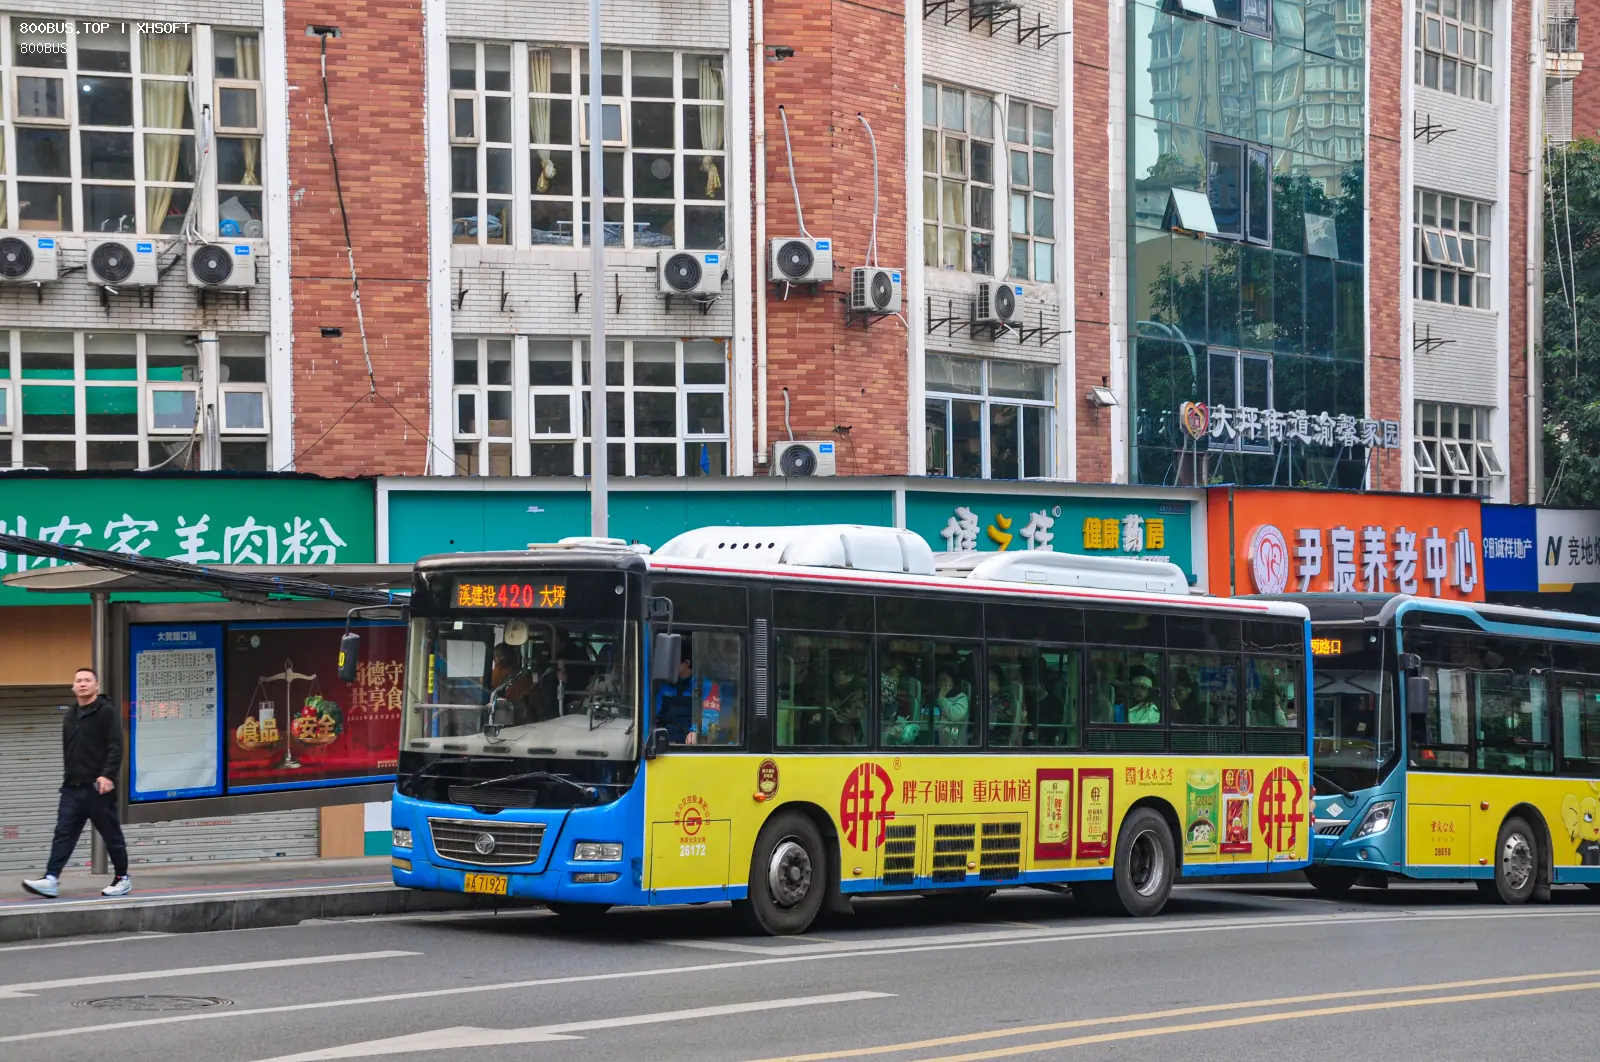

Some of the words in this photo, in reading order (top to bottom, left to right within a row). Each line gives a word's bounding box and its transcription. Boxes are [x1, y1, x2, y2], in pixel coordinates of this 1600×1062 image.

[1211, 403, 1400, 449] 大坪街道渝馨家园
[1083, 513, 1165, 552] 健康药房
[498, 583, 534, 608] 420
[539, 584, 566, 607] 大坪
[243, 717, 279, 742] 食品
[299, 714, 336, 739] 安全
[902, 780, 964, 804] 胖子调料
[972, 779, 1032, 803] 重庆味道
[679, 844, 706, 857] 26172
